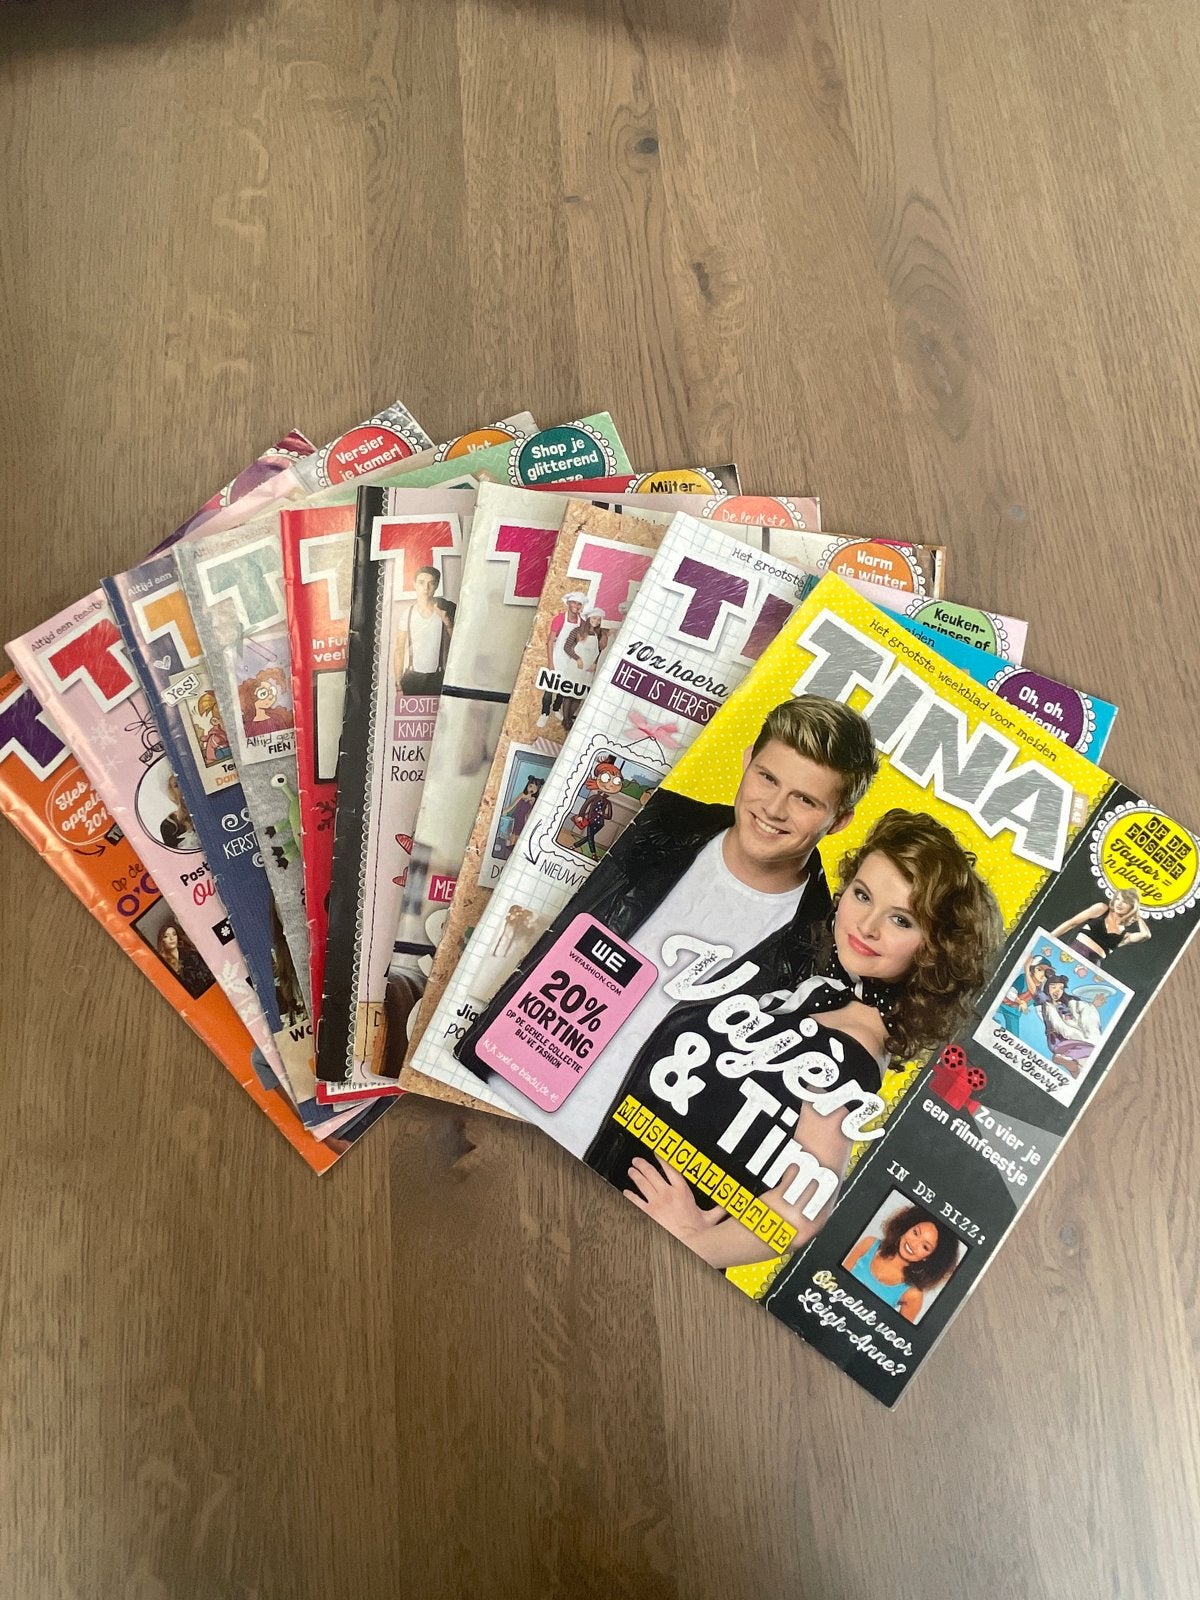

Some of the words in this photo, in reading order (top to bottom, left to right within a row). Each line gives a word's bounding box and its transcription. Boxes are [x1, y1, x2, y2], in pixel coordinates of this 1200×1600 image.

[336, 434, 384, 465] Versier
[527, 451, 598, 481] glitterend
[531, 442, 567, 460] Shop
[571, 437, 585, 455] je
[732, 547, 754, 564] Het
[837, 562, 854, 577] de
[858, 570, 908, 590] winter
[856, 550, 893, 571] Warm
[934, 607, 986, 634] Keuken-
[312, 638, 325, 650] In
[615, 663, 648, 692] HET
[648, 680, 666, 700] IS
[870, 618, 890, 638] Het
[888, 636, 936, 674] grootste
[938, 669, 989, 711] weekblad
[990, 709, 1016, 731] voor
[1016, 727, 1059, 762] meiden
[1018, 685, 1039, 708] Oh,
[1044, 700, 1065, 722] oh,
[793, 608, 1073, 870] TINA
[1111, 838, 1160, 880] Taylor
[1127, 825, 1185, 879] POSTER
[1147, 818, 1169, 840] OP
[1168, 837, 1190, 859] DE
[1113, 864, 1163, 901] plaatje
[569, 950, 623, 996] WEFASHION.COM
[591, 939, 627, 973] WE
[539, 969, 608, 1033] 20%
[506, 1010, 517, 1020] OP
[515, 1017, 525, 1028] DE
[524, 1023, 550, 1047] GEHELE
[548, 1041, 583, 1074] COLLECTIE
[517, 992, 594, 1059] KORTING
[515, 1028, 528, 1041] BIJ
[535, 1045, 563, 1069] FASHION
[992, 1042, 1019, 1064] voor
[1020, 1058, 1059, 1093] Cherry
[1015, 1042, 1069, 1087] verrassing
[649, 1031, 711, 1116] &
[716, 1077, 839, 1221] Tim
[922, 1098, 950, 1125] een
[949, 1118, 1029, 1187] filmfeestje
[974, 1106, 995, 1131] Zo
[994, 1126, 1025, 1151] vier
[1020, 1145, 1042, 1166] je
[615, 1098, 793, 1250] MUSICALSETJE
[886, 1160, 911, 1182] IN
[912, 1180, 937, 1204] DE
[939, 1202, 986, 1246] BIZZ:
[798, 1288, 907, 1377] Leigh-Anne?
[812, 1270, 878, 1327] Ongeluk
[874, 1322, 913, 1357] voor
